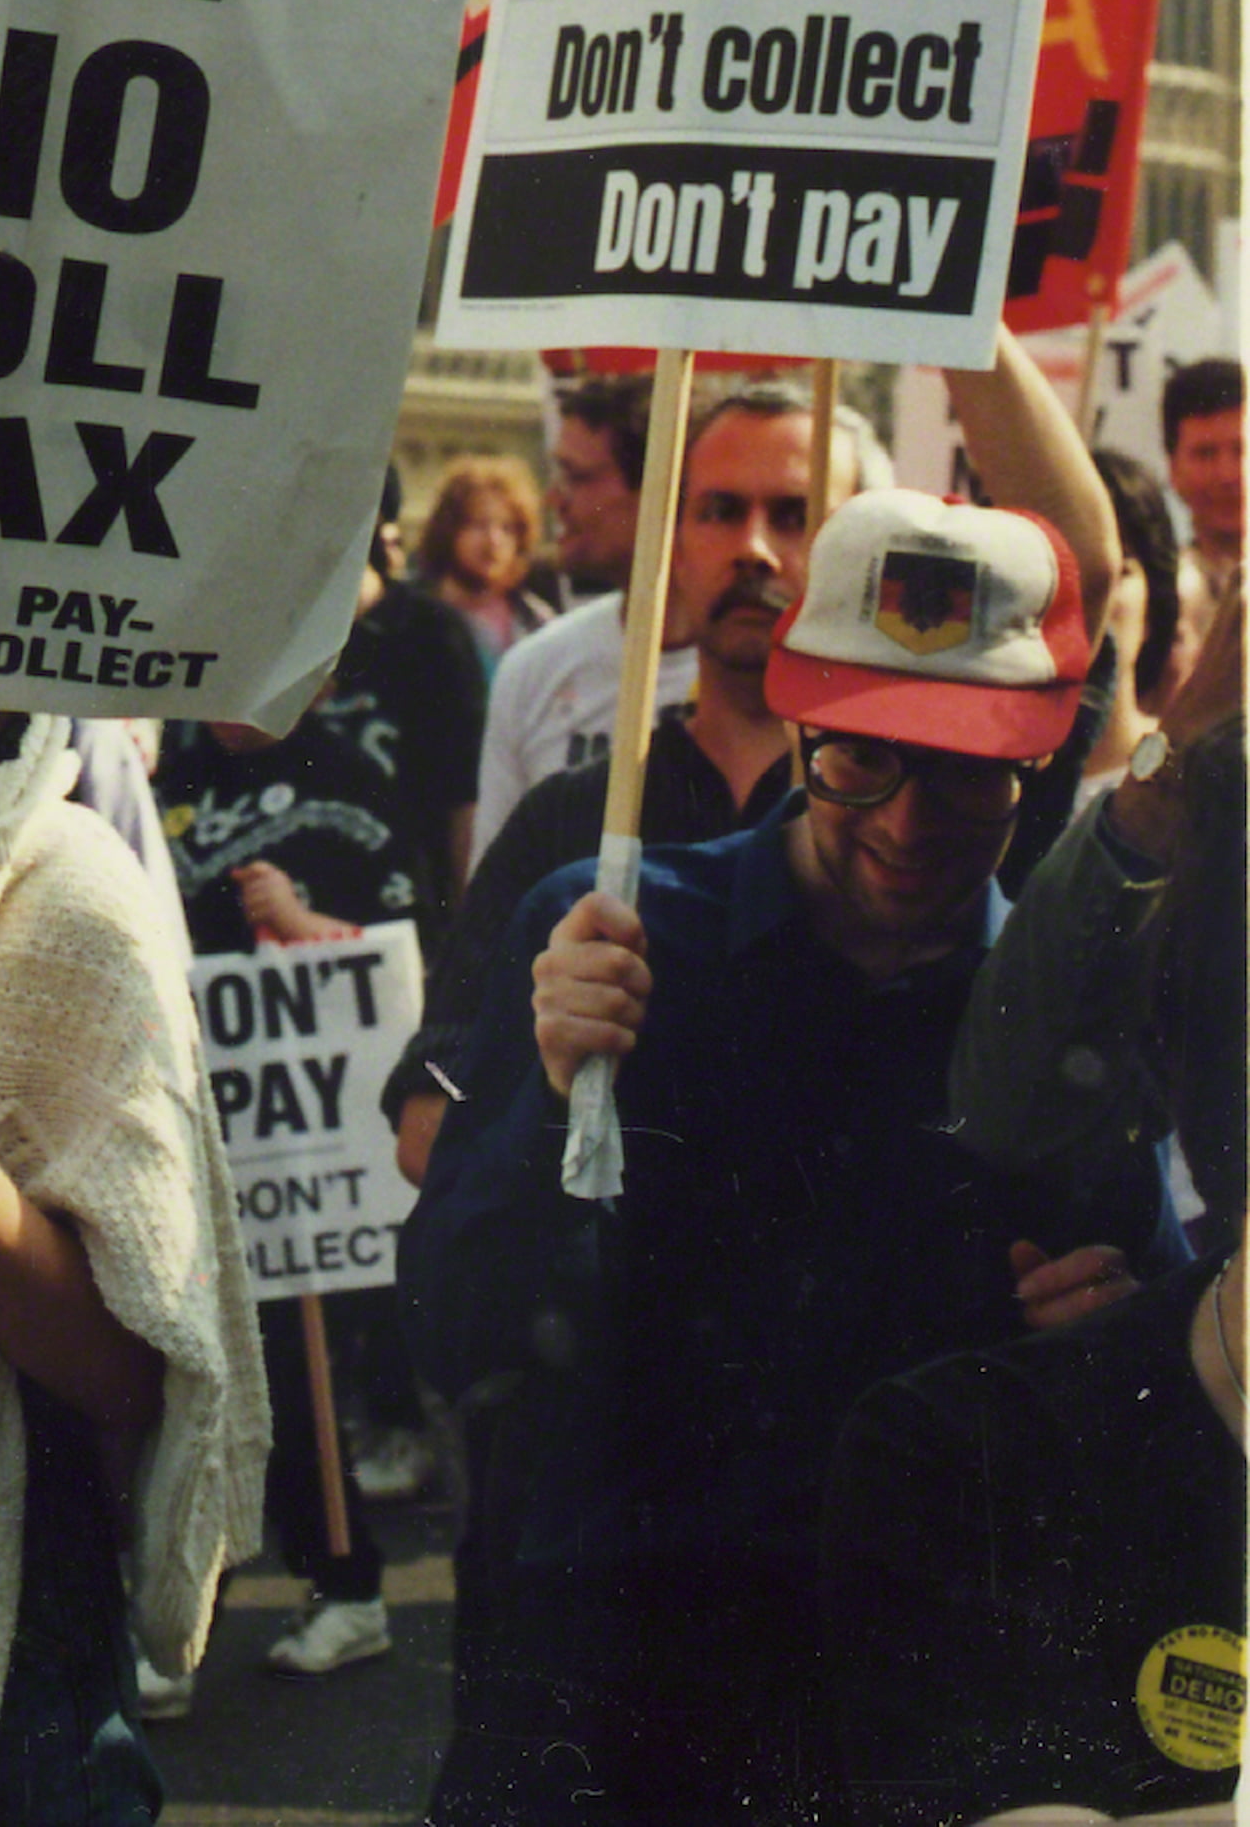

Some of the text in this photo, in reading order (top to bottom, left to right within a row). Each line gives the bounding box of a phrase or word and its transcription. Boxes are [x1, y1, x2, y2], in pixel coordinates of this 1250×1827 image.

[546, 12, 982, 124] Don't collect
[594, 170, 960, 298] Don't pay
[192, 953, 383, 1046] ON'T
[211, 1053, 347, 1145] PAY
[1170, 1674, 1245, 1710] DEMO
